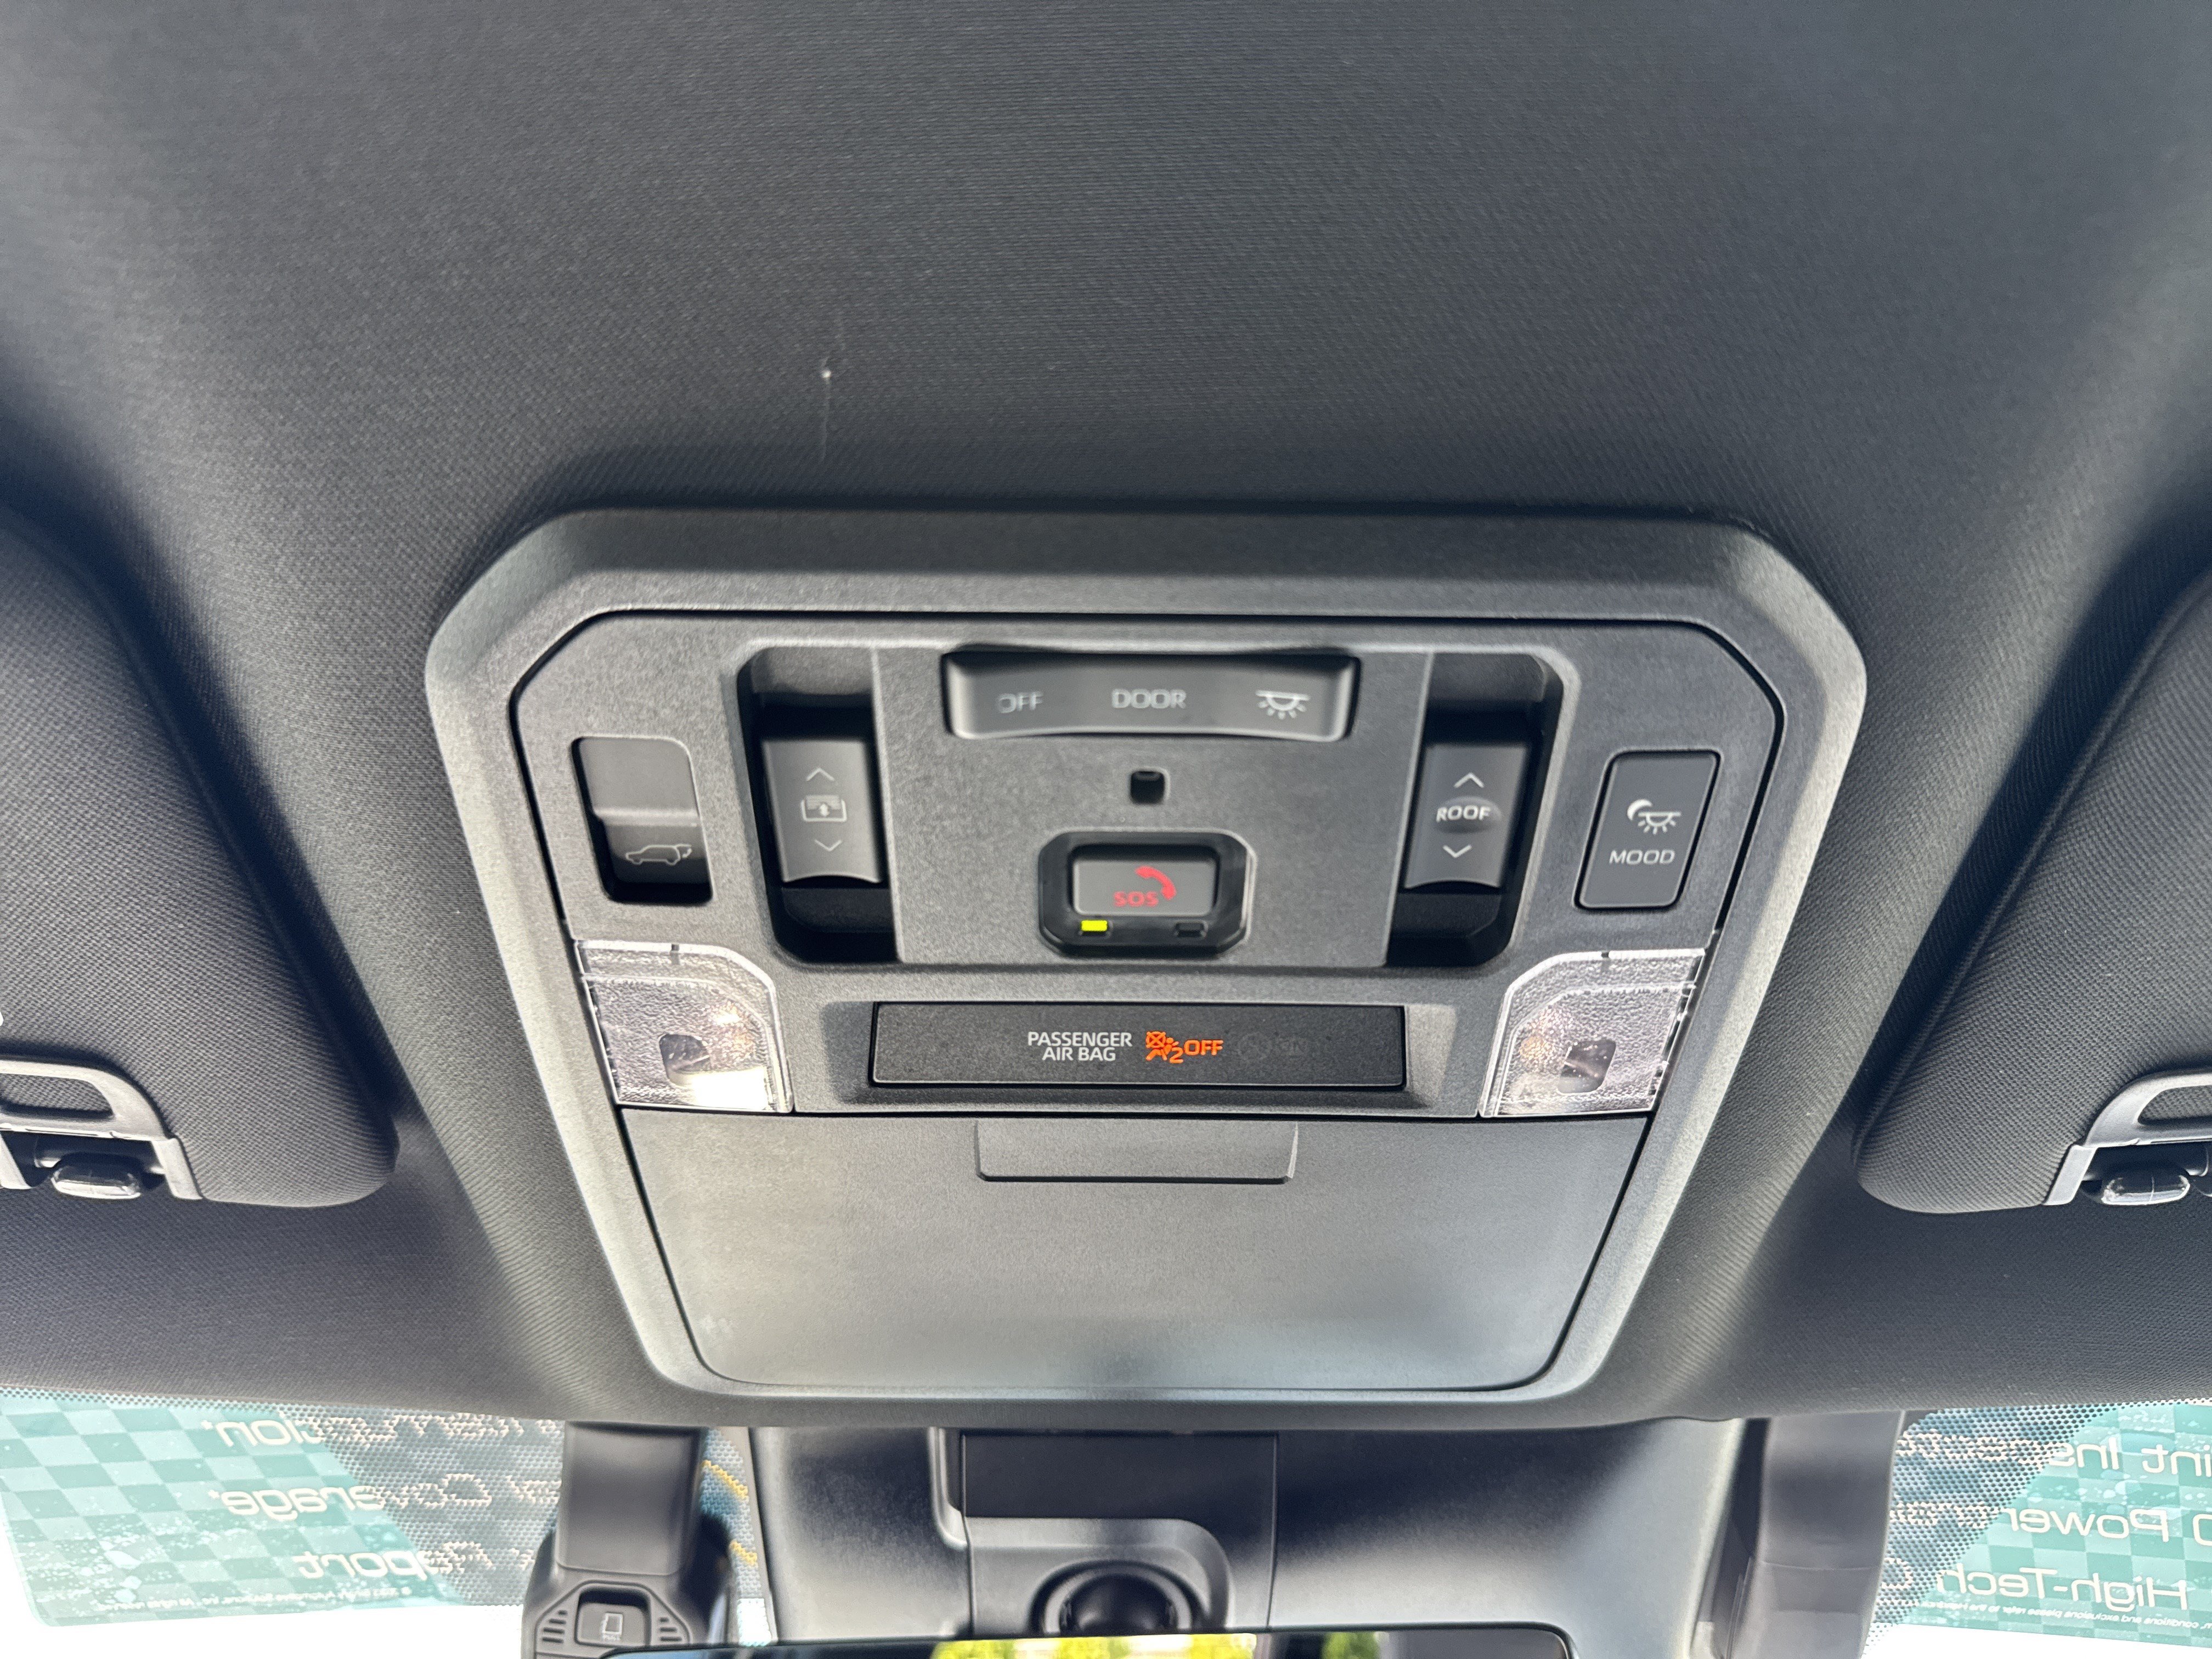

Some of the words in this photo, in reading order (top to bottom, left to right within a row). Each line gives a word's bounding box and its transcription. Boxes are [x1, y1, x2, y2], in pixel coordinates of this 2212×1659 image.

[997, 690, 1044, 714] OFF
[1111, 689, 1187, 709] DOOR
[1436, 805, 1491, 822] ROOF
[1609, 849, 1675, 865] MOOD
[1113, 890, 1159, 907] SOS
[1028, 1031, 1132, 1047] PASSENGER
[1184, 1039, 1223, 1056] OFF
[1042, 1047, 1074, 1062] AIR
[1078, 1047, 1116, 1062] BAG
